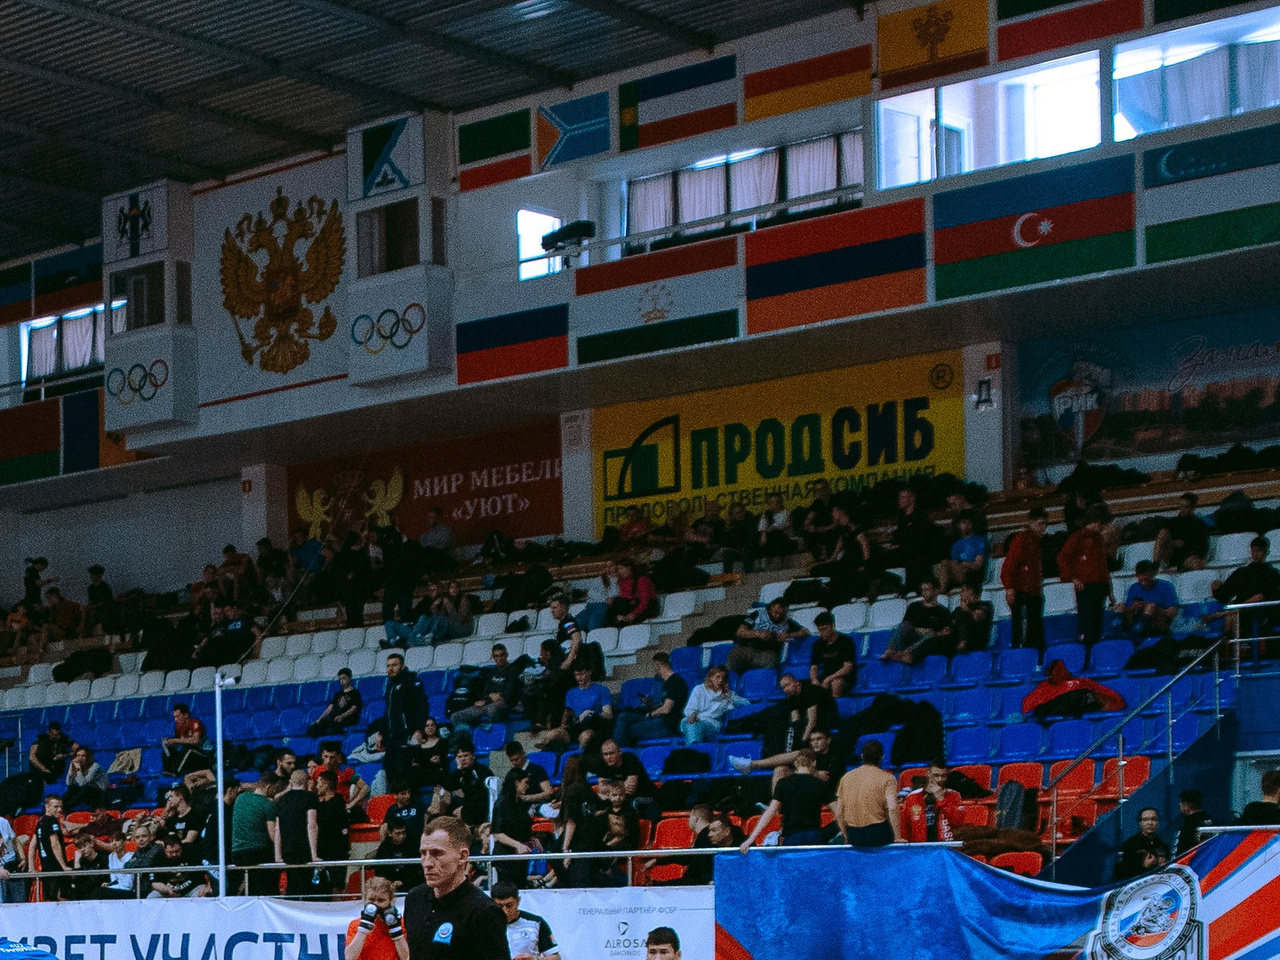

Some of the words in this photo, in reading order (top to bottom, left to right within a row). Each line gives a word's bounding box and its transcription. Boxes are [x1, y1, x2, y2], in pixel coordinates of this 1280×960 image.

[690, 397, 936, 489] ПРОДСИБ
[412, 473, 464, 500] МИР
[603, 481, 818, 525] ПРДОВОЛСТВЕННАЯ
[578, 907, 622, 915] ГЕНЕРАЛЬНЫЙ
[658, 906, 678, 914] ФСБР
[604, 938, 647, 948] ALROSA
